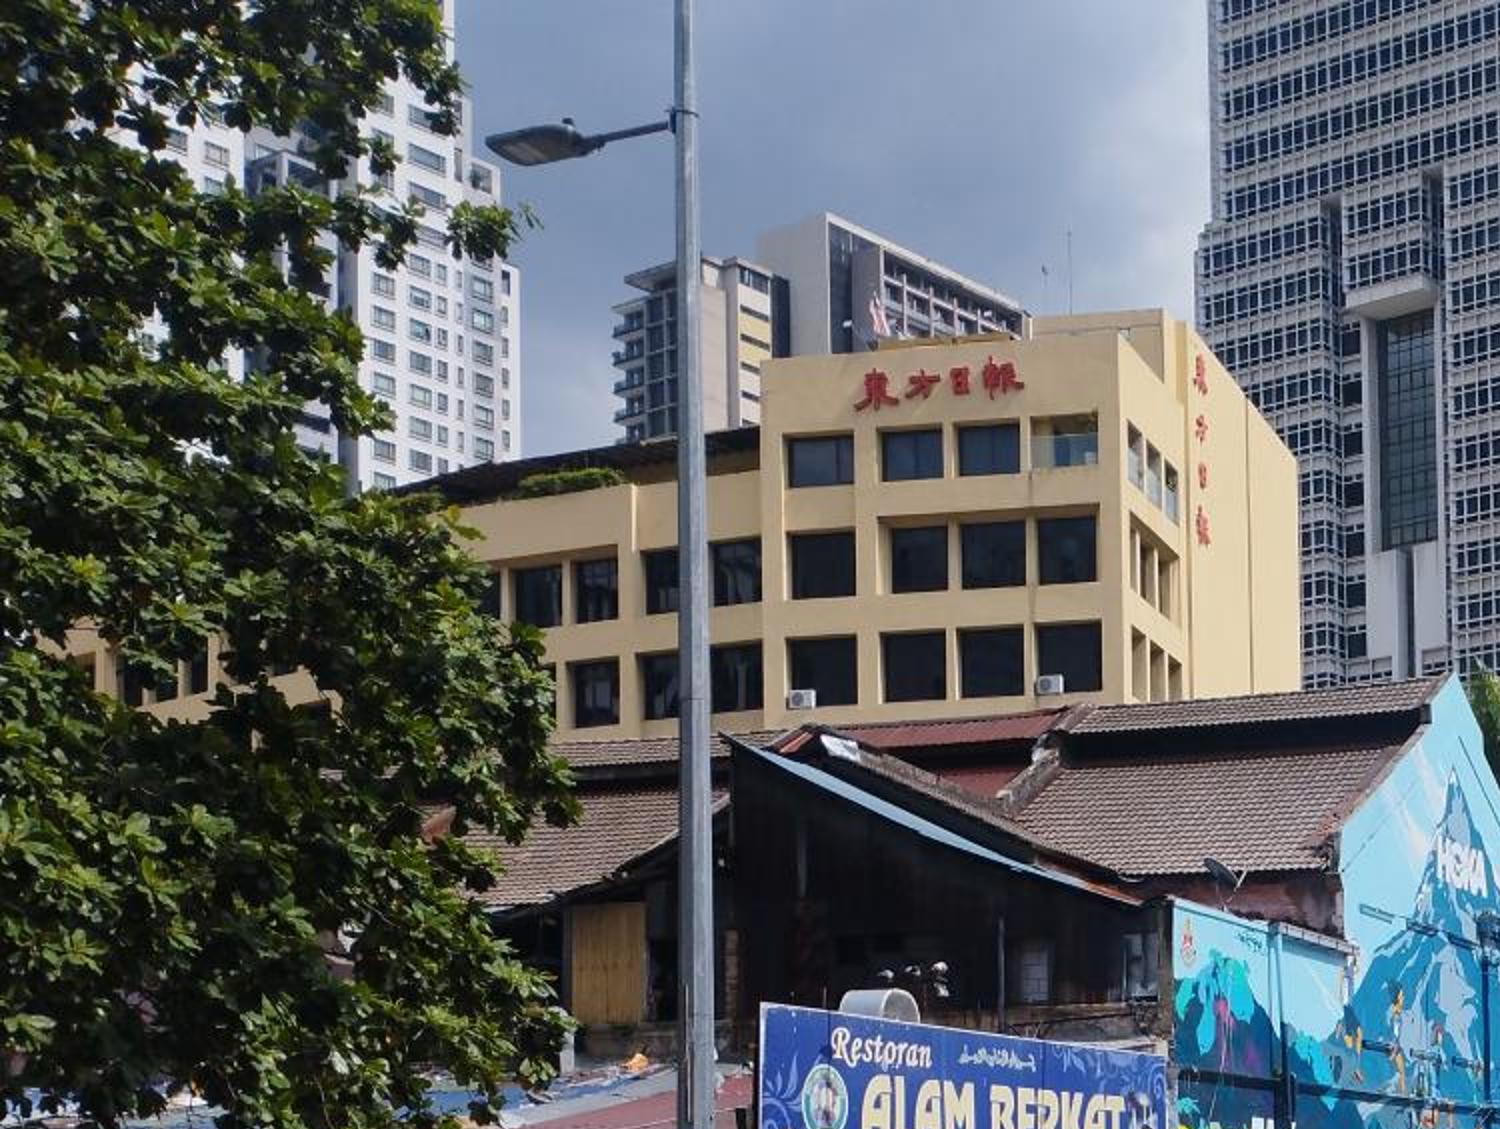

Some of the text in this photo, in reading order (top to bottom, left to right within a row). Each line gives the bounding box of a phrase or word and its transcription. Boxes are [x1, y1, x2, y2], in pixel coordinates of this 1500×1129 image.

[853, 355, 1025, 412] 東方日報
[831, 1026, 933, 1072] Restoran
